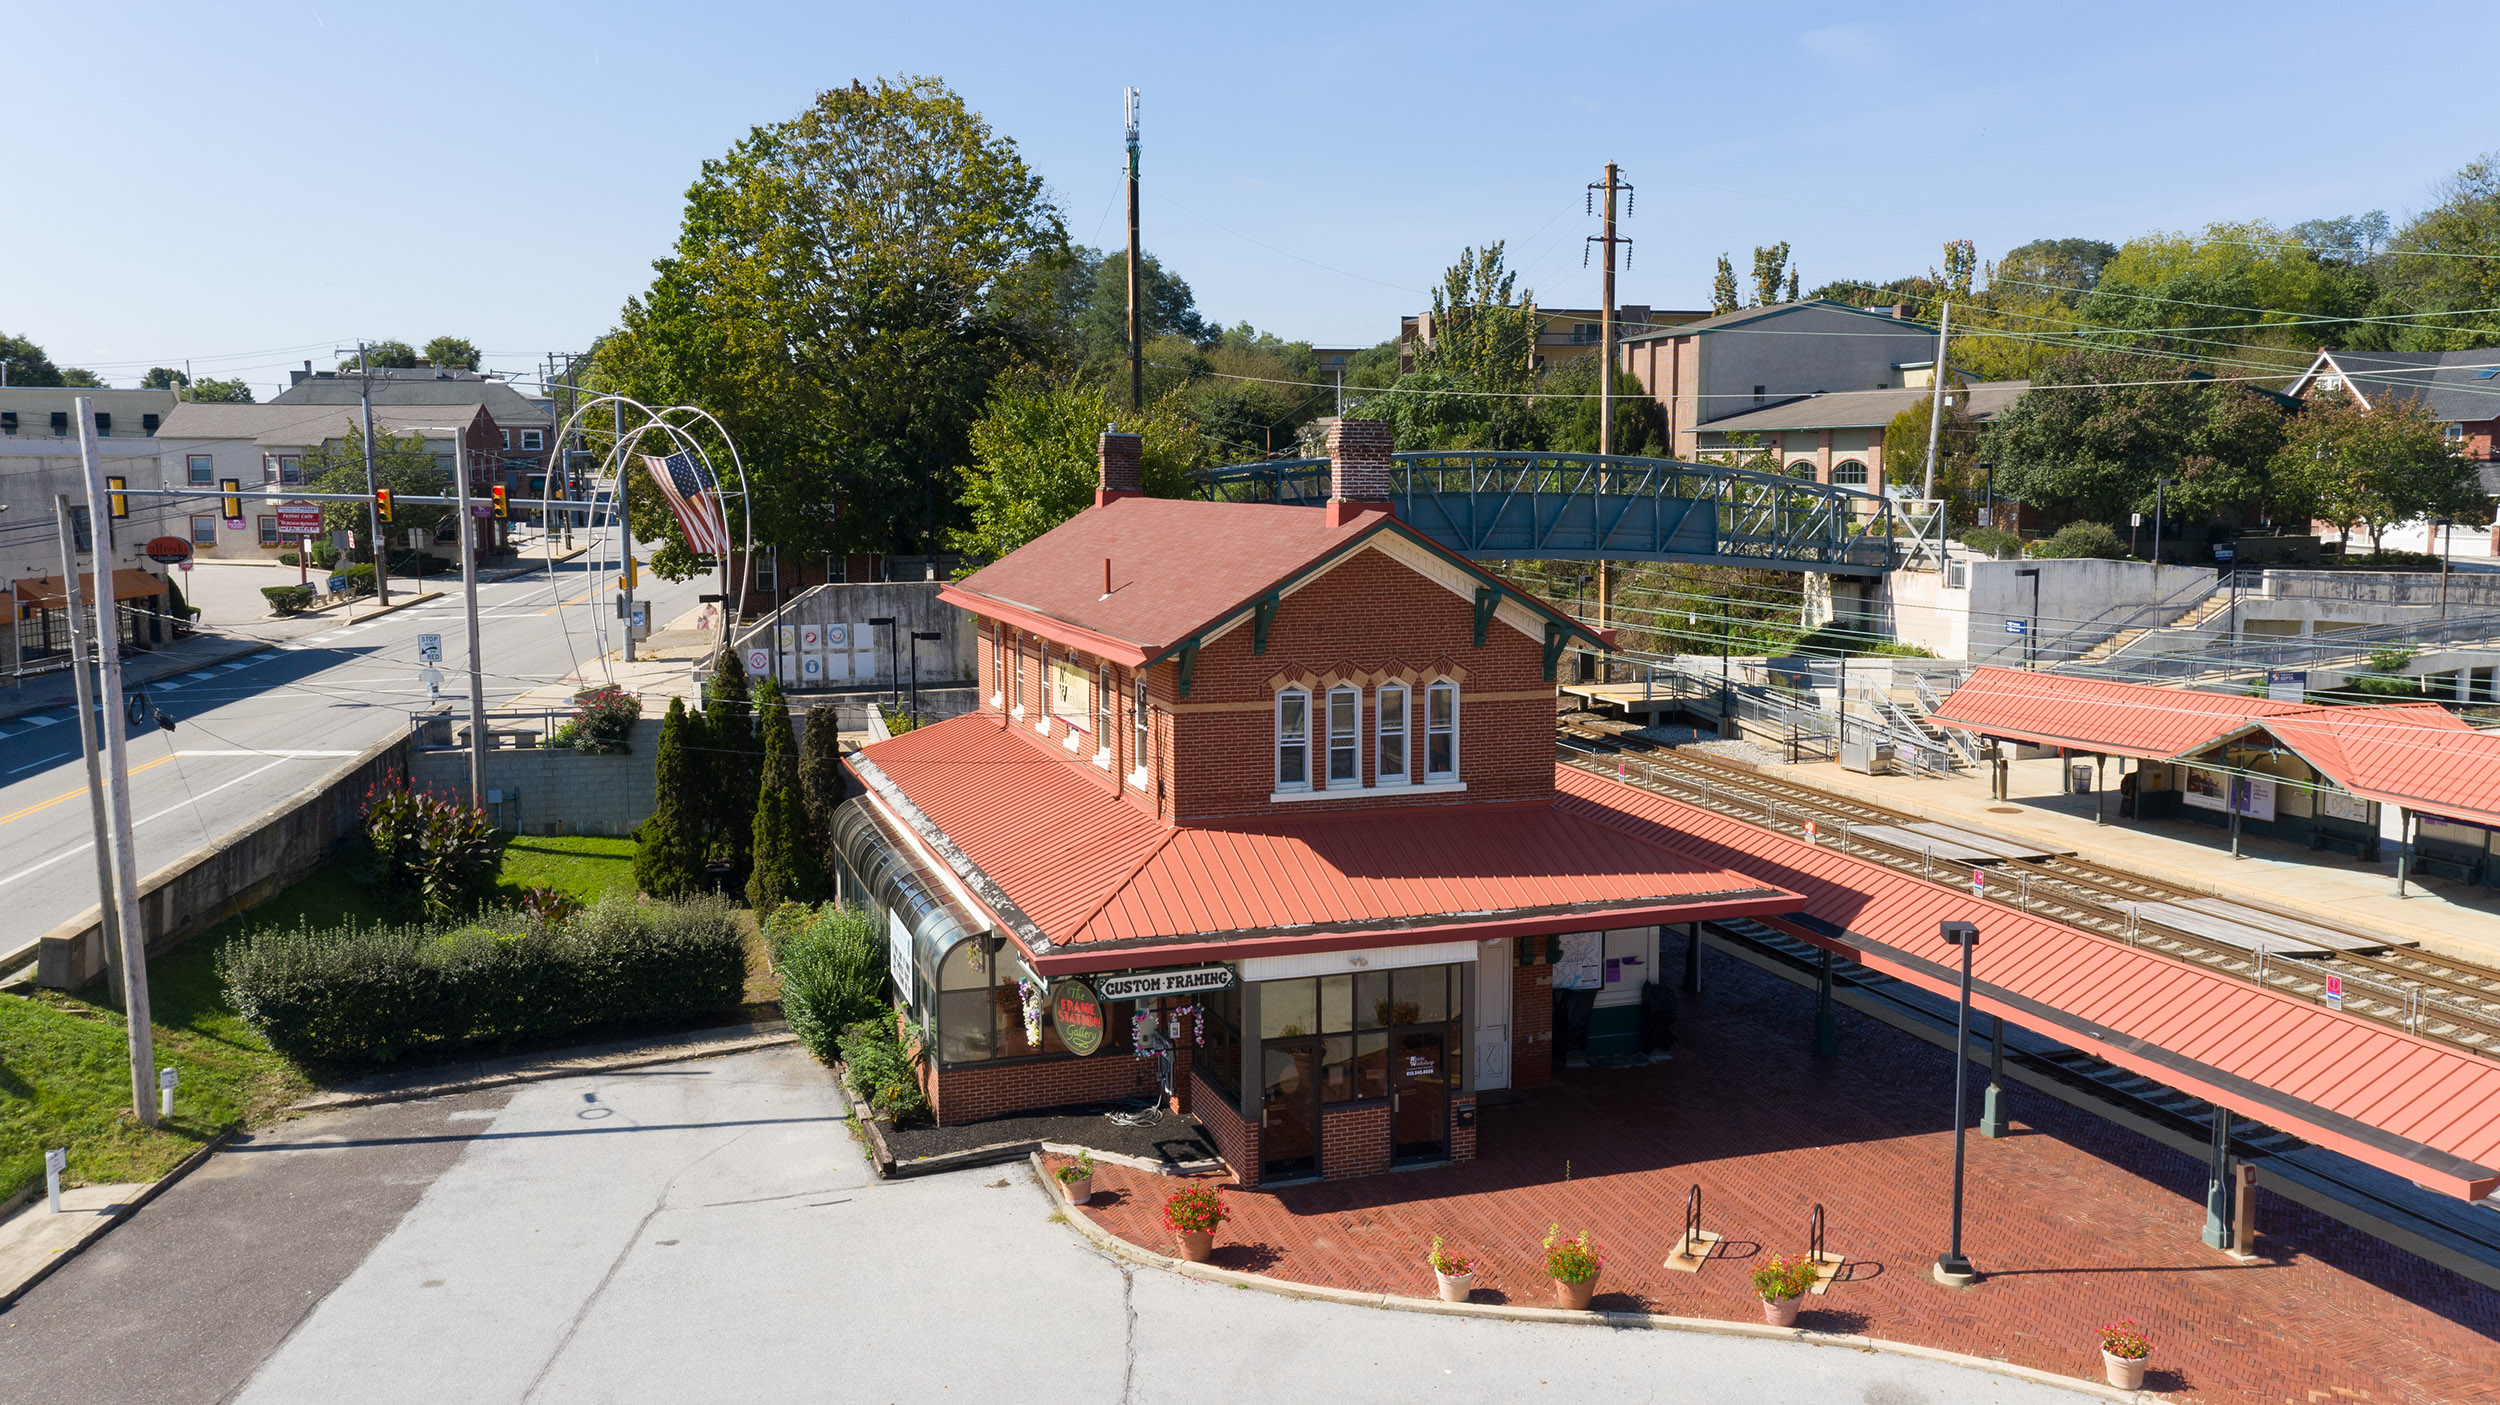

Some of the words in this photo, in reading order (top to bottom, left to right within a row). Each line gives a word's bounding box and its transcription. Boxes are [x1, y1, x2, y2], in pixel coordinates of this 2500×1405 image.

[148, 543, 188, 554] alfredo
[1105, 977, 1160, 995] CUSTOM
[1166, 971, 1228, 989] FRAMING
[1068, 985, 1086, 1000] The
[1061, 998, 1096, 1016] FRAME
[1057, 1010, 1101, 1028] STATION
[1066, 1024, 1097, 1044] Gallery
